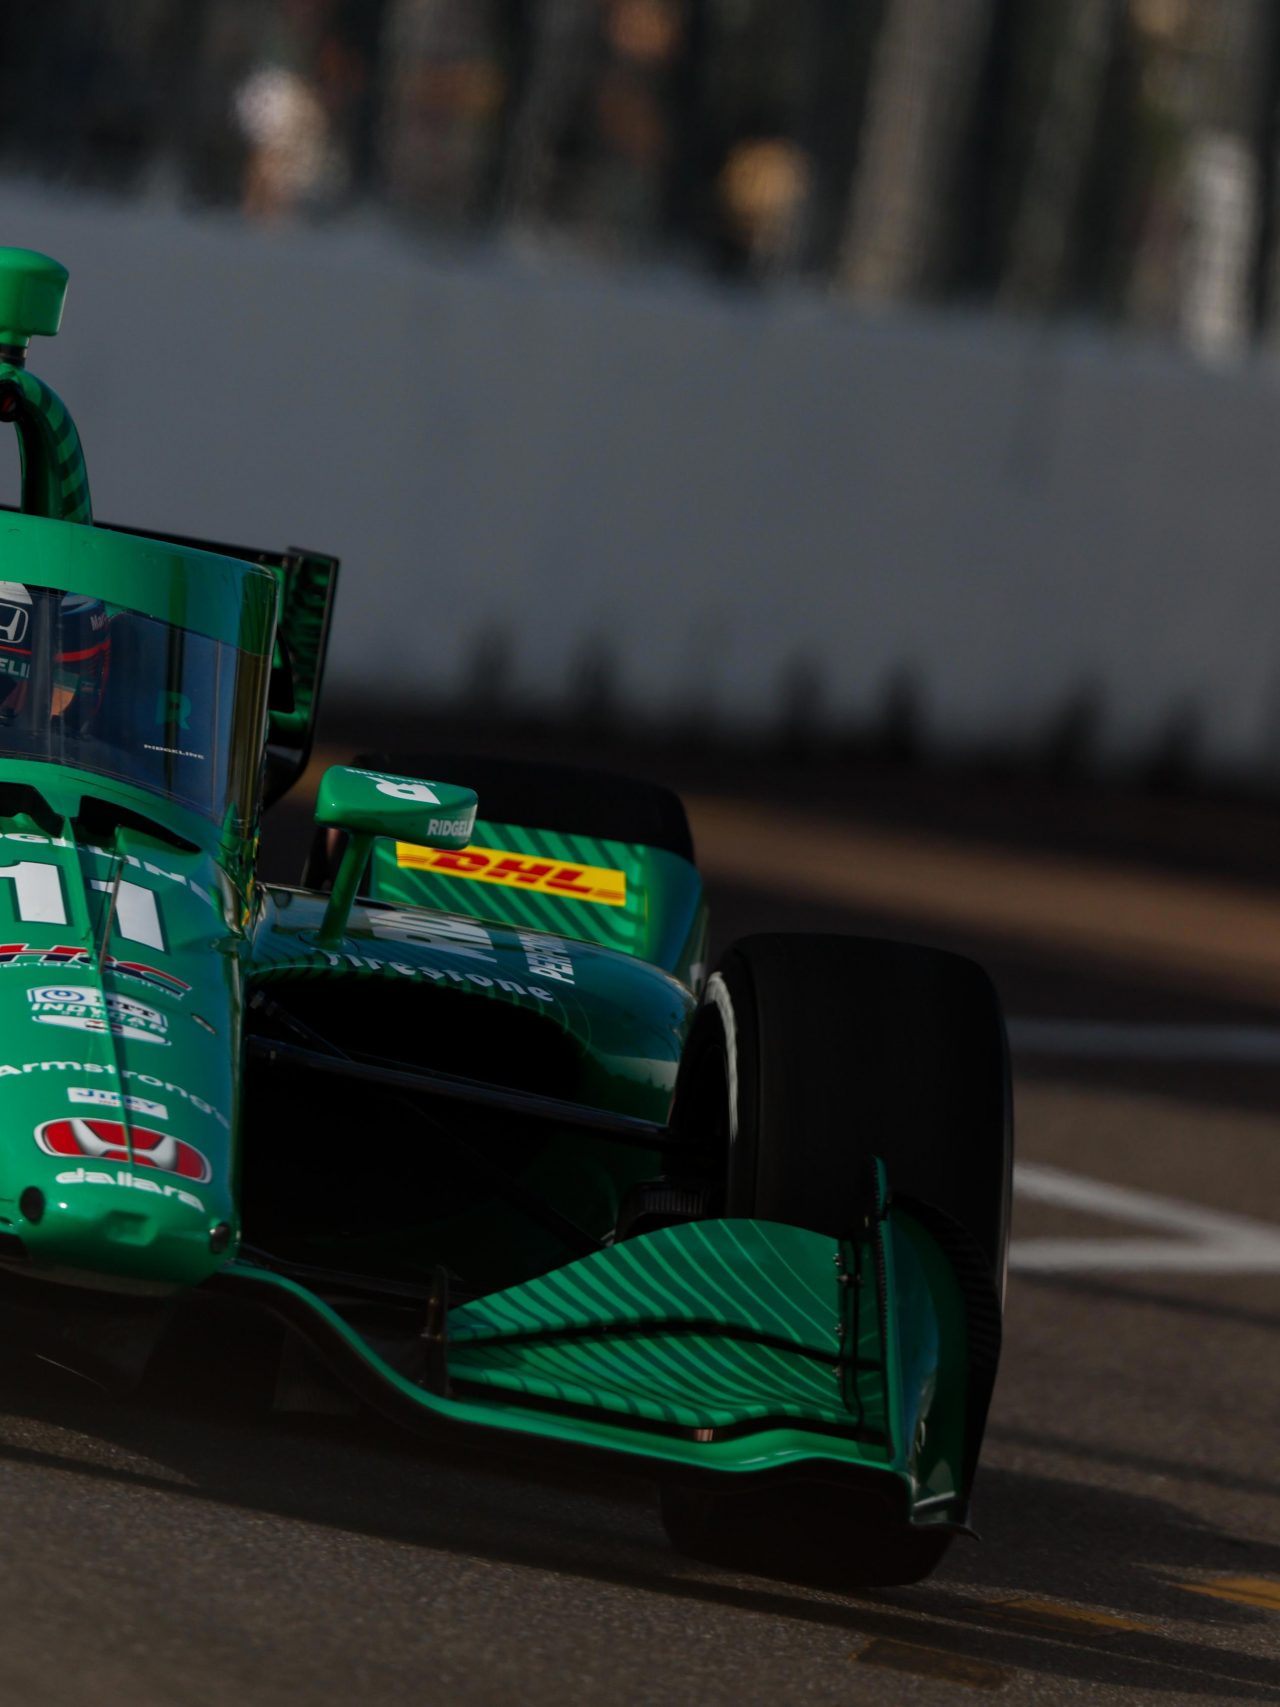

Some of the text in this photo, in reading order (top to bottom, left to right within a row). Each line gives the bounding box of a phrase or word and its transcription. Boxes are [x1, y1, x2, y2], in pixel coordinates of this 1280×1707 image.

[431, 849, 593, 894] DHL
[309, 947, 555, 1003] Firestone
[55, 1167, 206, 1213] dallara
